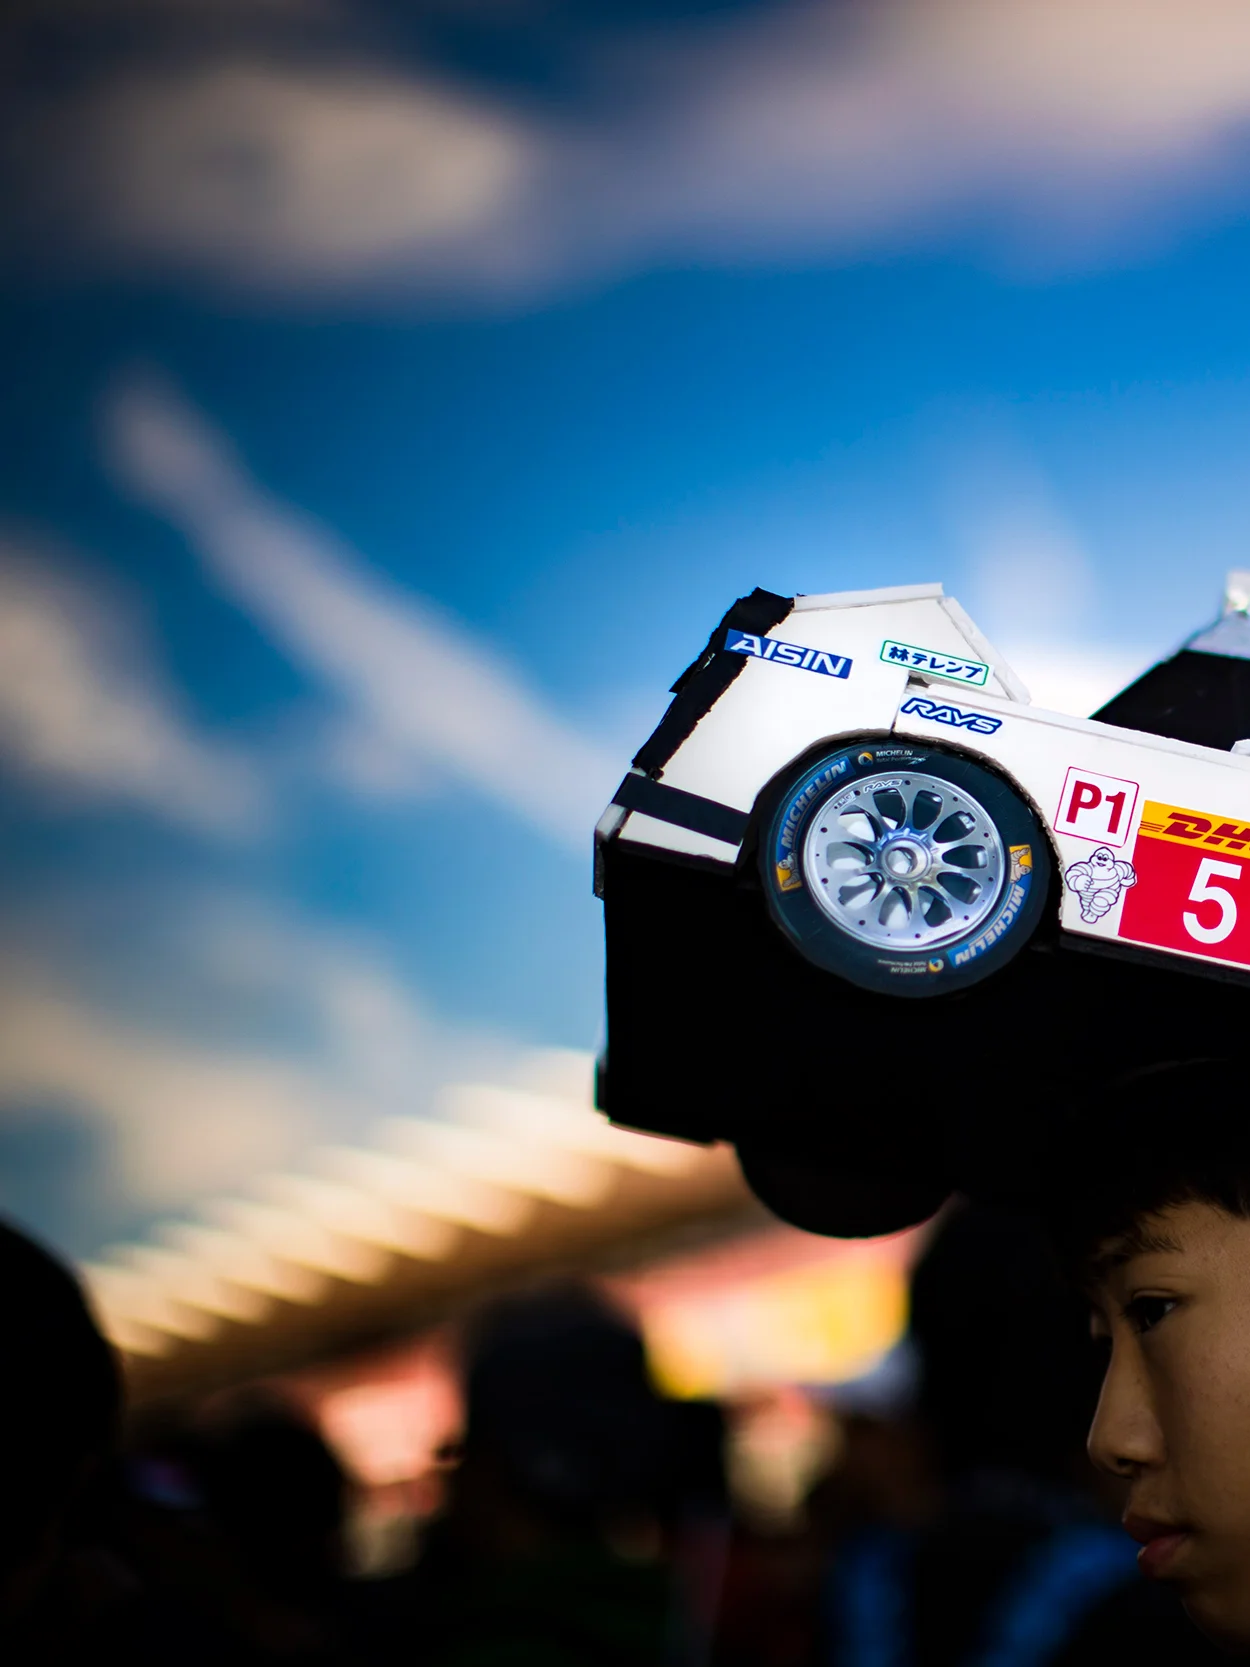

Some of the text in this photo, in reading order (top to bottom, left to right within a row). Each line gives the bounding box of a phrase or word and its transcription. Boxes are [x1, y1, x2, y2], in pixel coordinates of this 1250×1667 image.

[730, 633, 847, 676] AISIN
[888, 645, 983, 679] 林テレンプ
[902, 698, 1001, 734] RAYS
[875, 749, 914, 757] MICHELIN
[781, 760, 847, 849] MICHELIN
[1064, 779, 1128, 836] P1
[955, 884, 1025, 966] MICHELIN
[1182, 858, 1243, 944] 5
